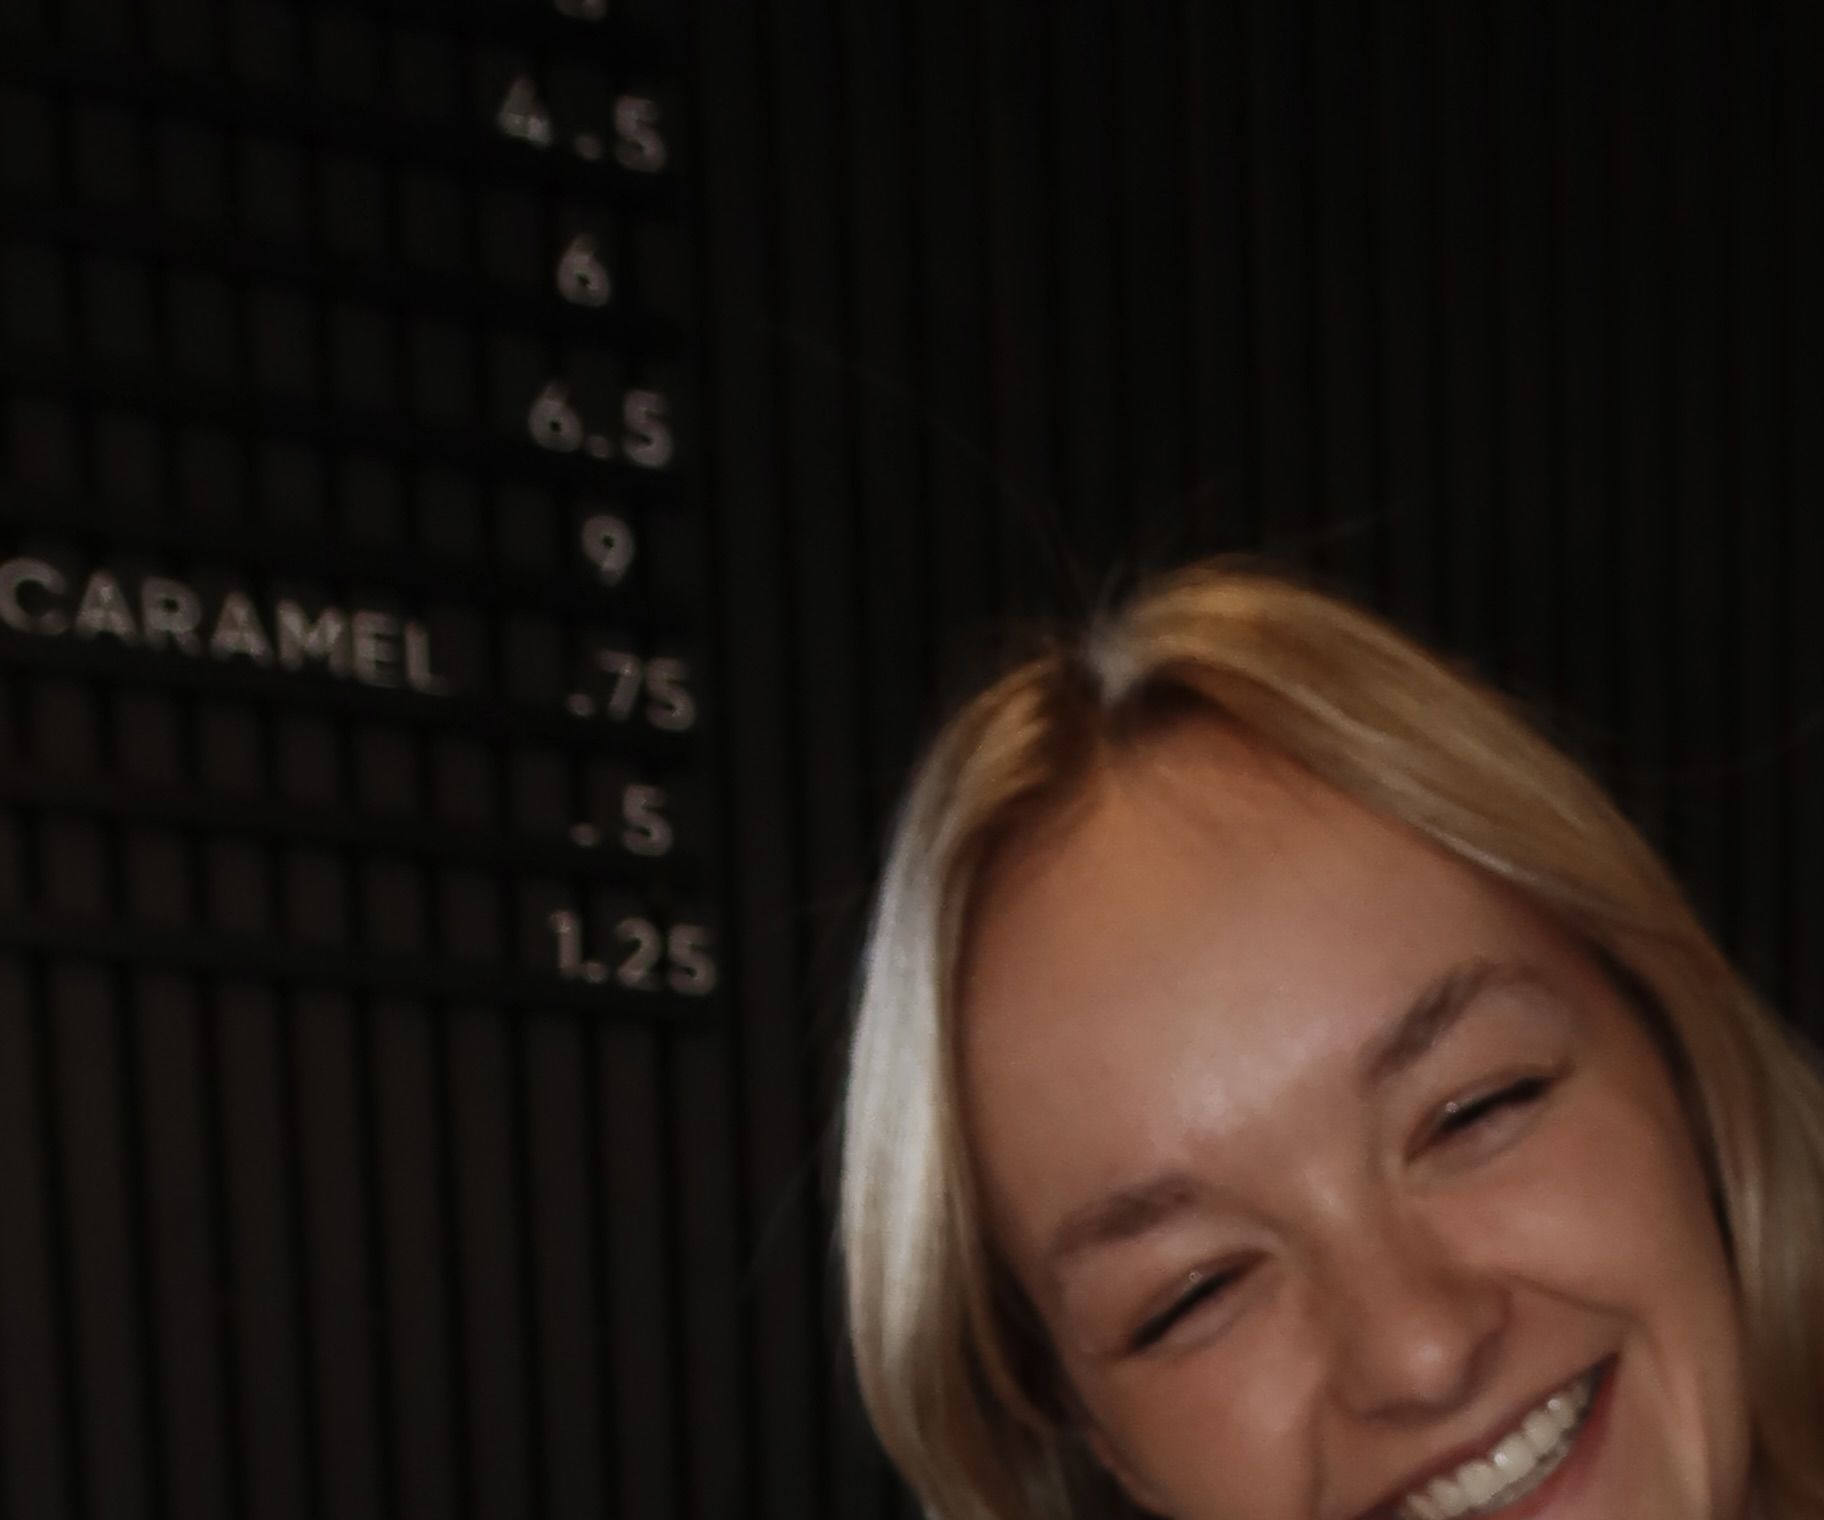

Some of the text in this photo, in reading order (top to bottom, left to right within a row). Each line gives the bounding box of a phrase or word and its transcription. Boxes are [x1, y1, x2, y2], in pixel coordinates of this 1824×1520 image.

[498, 76, 668, 172] 4.5
[556, 233, 611, 307] 6
[527, 380, 674, 469] 6.5
[580, 513, 635, 587] 9
[0, 556, 697, 732] CARAMEL .75
[548, 907, 717, 996] 1.25
